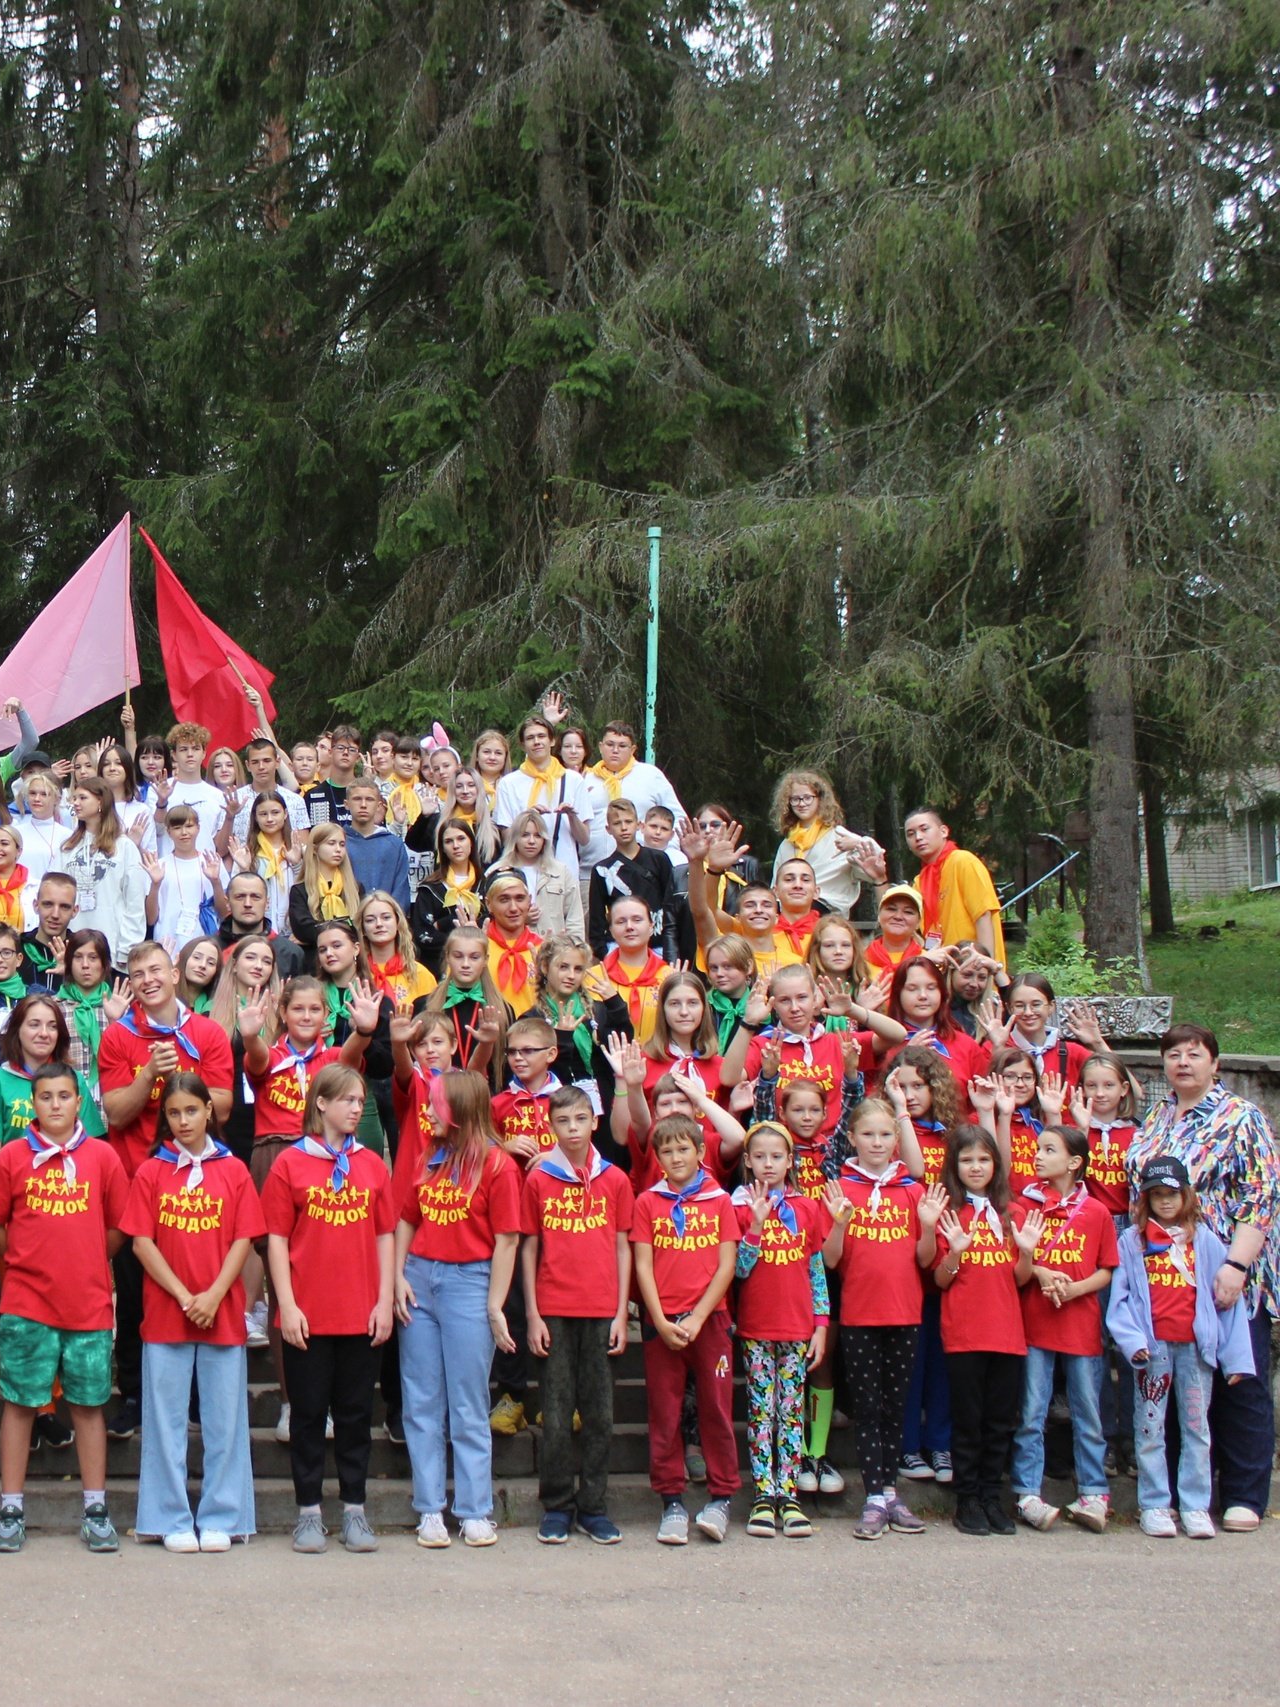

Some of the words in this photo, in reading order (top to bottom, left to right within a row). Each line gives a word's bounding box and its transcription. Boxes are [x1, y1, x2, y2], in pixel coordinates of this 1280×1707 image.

[270, 1091, 306, 1113] ПРУД
[1086, 1166, 1128, 1186] РУДО
[26, 1195, 89, 1217] ПРУДОК
[308, 1204, 368, 1227] ПРУДОК
[682, 1206, 699, 1216] ОЛ
[159, 1211, 221, 1234] ПРУДОК
[543, 1213, 608, 1234] ПРУДОК
[653, 1233, 719, 1252] ПРУДОК
[848, 1224, 910, 1244] ПРУДОК
[758, 1248, 805, 1267] РУДОК
[961, 1250, 1013, 1268] РУДОК
[1034, 1247, 1083, 1266] РДОК
[1147, 1271, 1188, 1288] РУД
